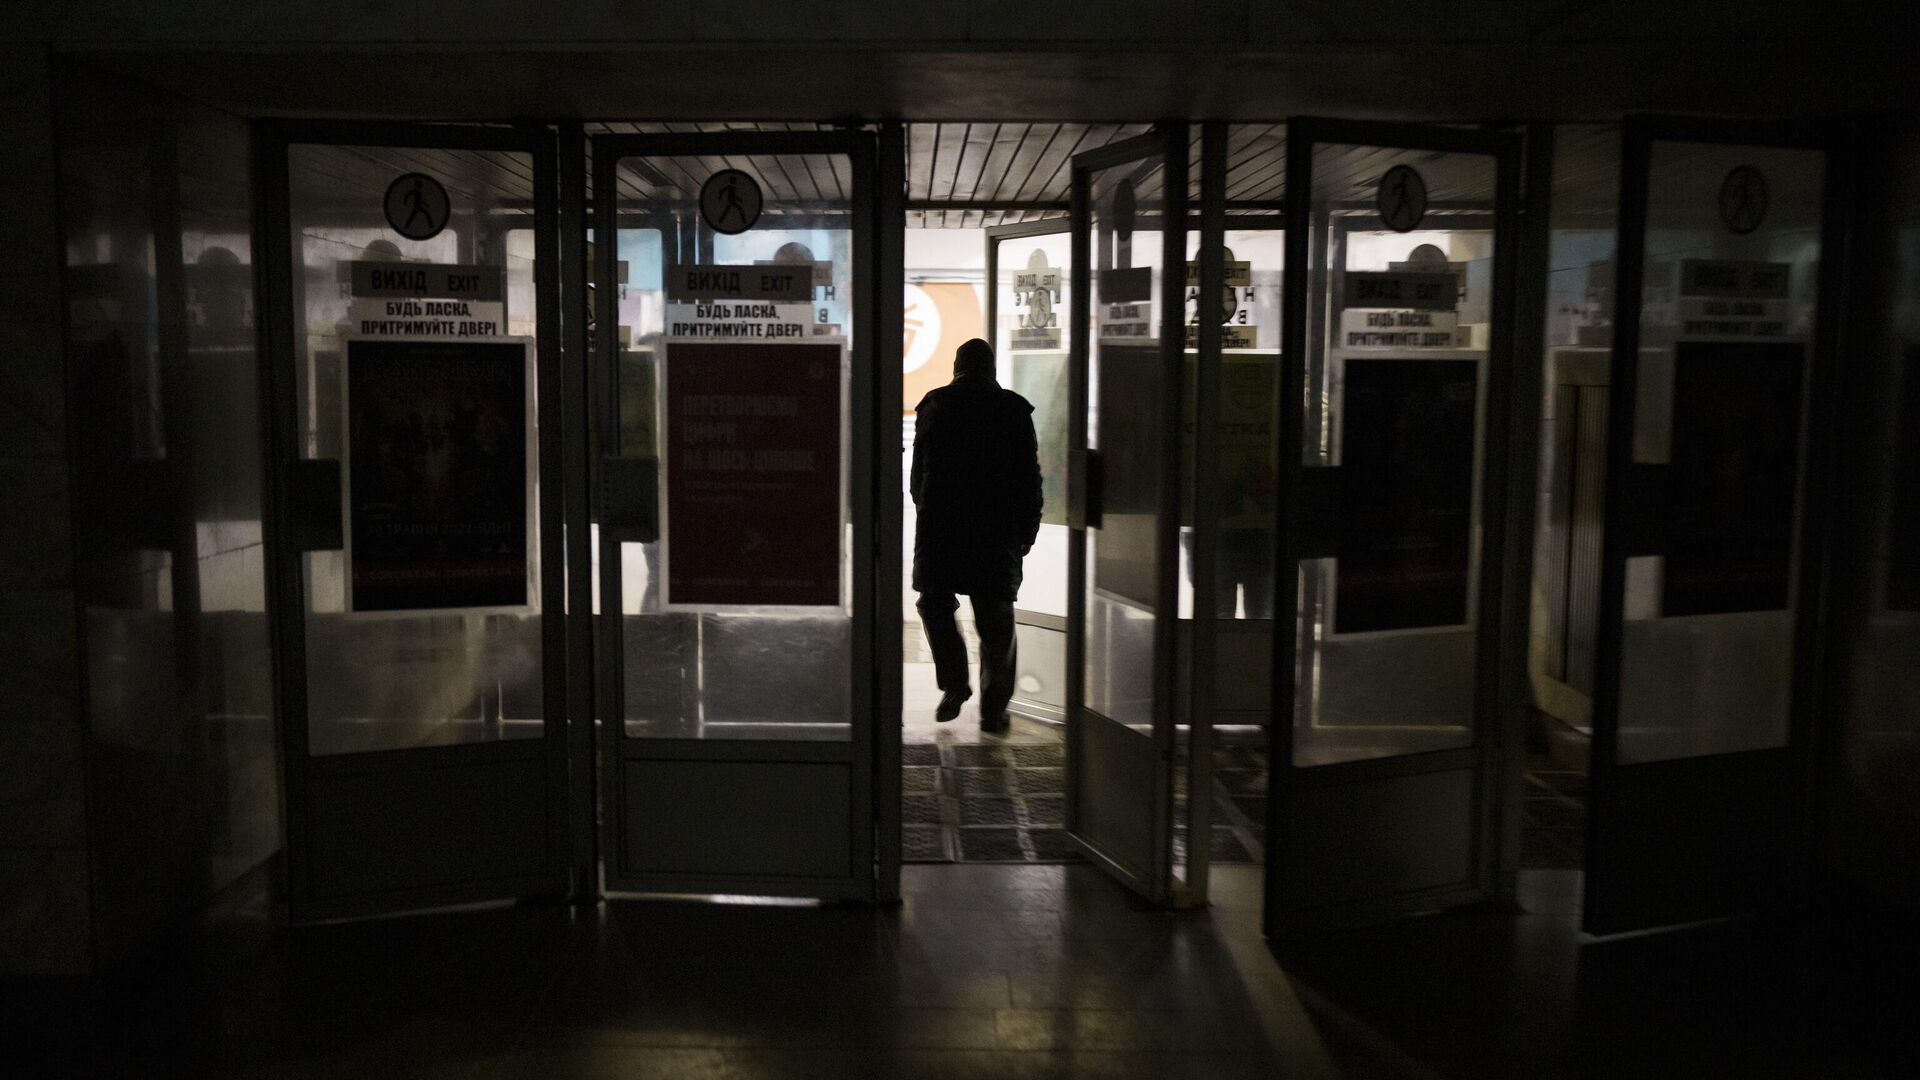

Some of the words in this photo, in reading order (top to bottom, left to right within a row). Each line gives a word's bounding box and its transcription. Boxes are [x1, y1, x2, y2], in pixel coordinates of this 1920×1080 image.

[372, 269, 427, 294] ВИХІД
[448, 275, 480, 292] EXIT
[687, 272, 742, 294] ВИХІД
[761, 275, 793, 292] EXIT
[386, 302, 422, 317] БУДЬ
[426, 302, 472, 317] ЛАСКА,
[697, 304, 731, 319] БУДЬ
[733, 304, 780, 319] ЛАСКА,
[361, 319, 455, 335] ПРИТРИМУЙТЕ
[458, 321, 496, 336] ДВЕРІ
[672, 321, 763, 338] ПРИТРИМУЙТЕ
[765, 323, 803, 339] ДВЕРІ
